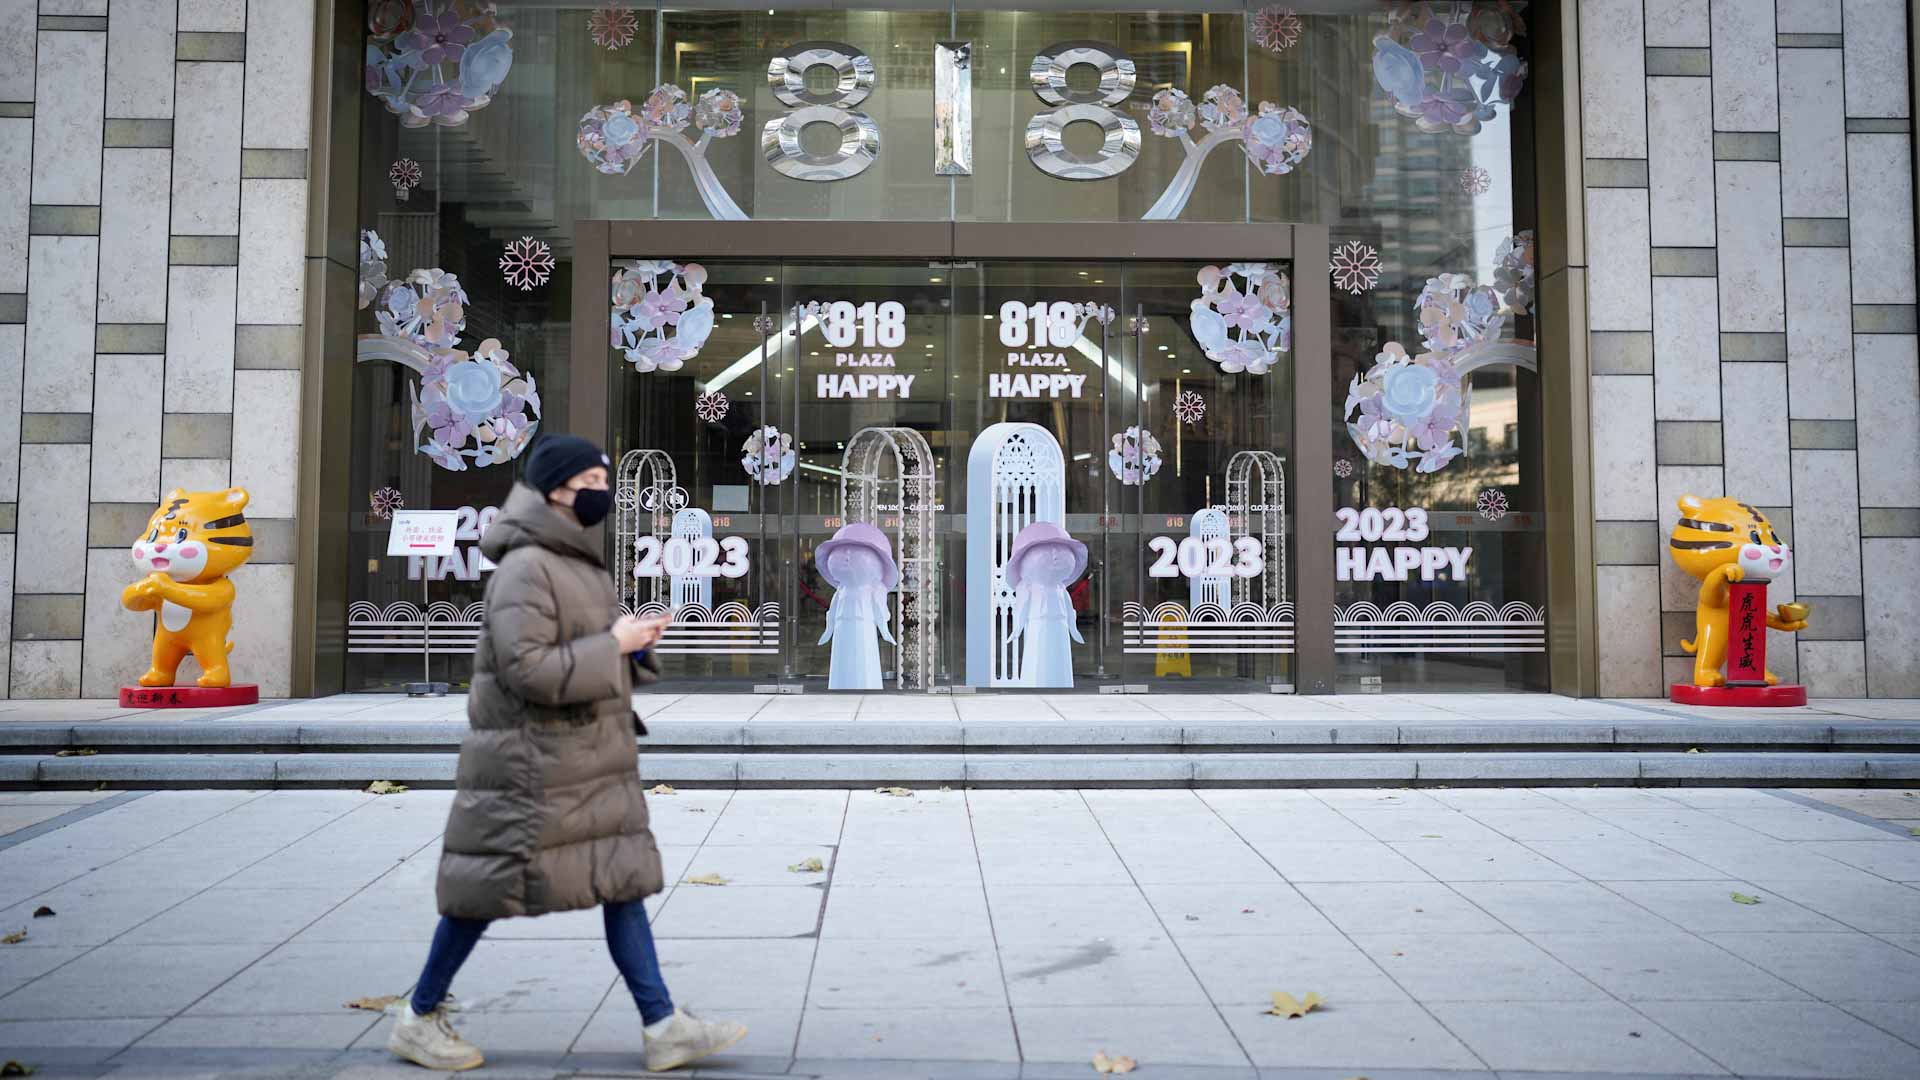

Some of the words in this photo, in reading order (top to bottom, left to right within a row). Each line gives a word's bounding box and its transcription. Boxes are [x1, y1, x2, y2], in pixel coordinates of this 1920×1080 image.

[761, 40, 1142, 182] 818
[828, 301, 906, 348] 818
[999, 301, 1077, 348] 818
[835, 353, 896, 367] PLAZA
[1007, 353, 1067, 367] PLAZA
[817, 374, 915, 398] HAPPY
[989, 374, 1087, 398] HAPPY
[1335, 507, 1430, 541] 2023
[633, 536, 750, 578] 2023
[1148, 536, 1264, 578] 2023
[1336, 547, 1473, 581] HAPPY
